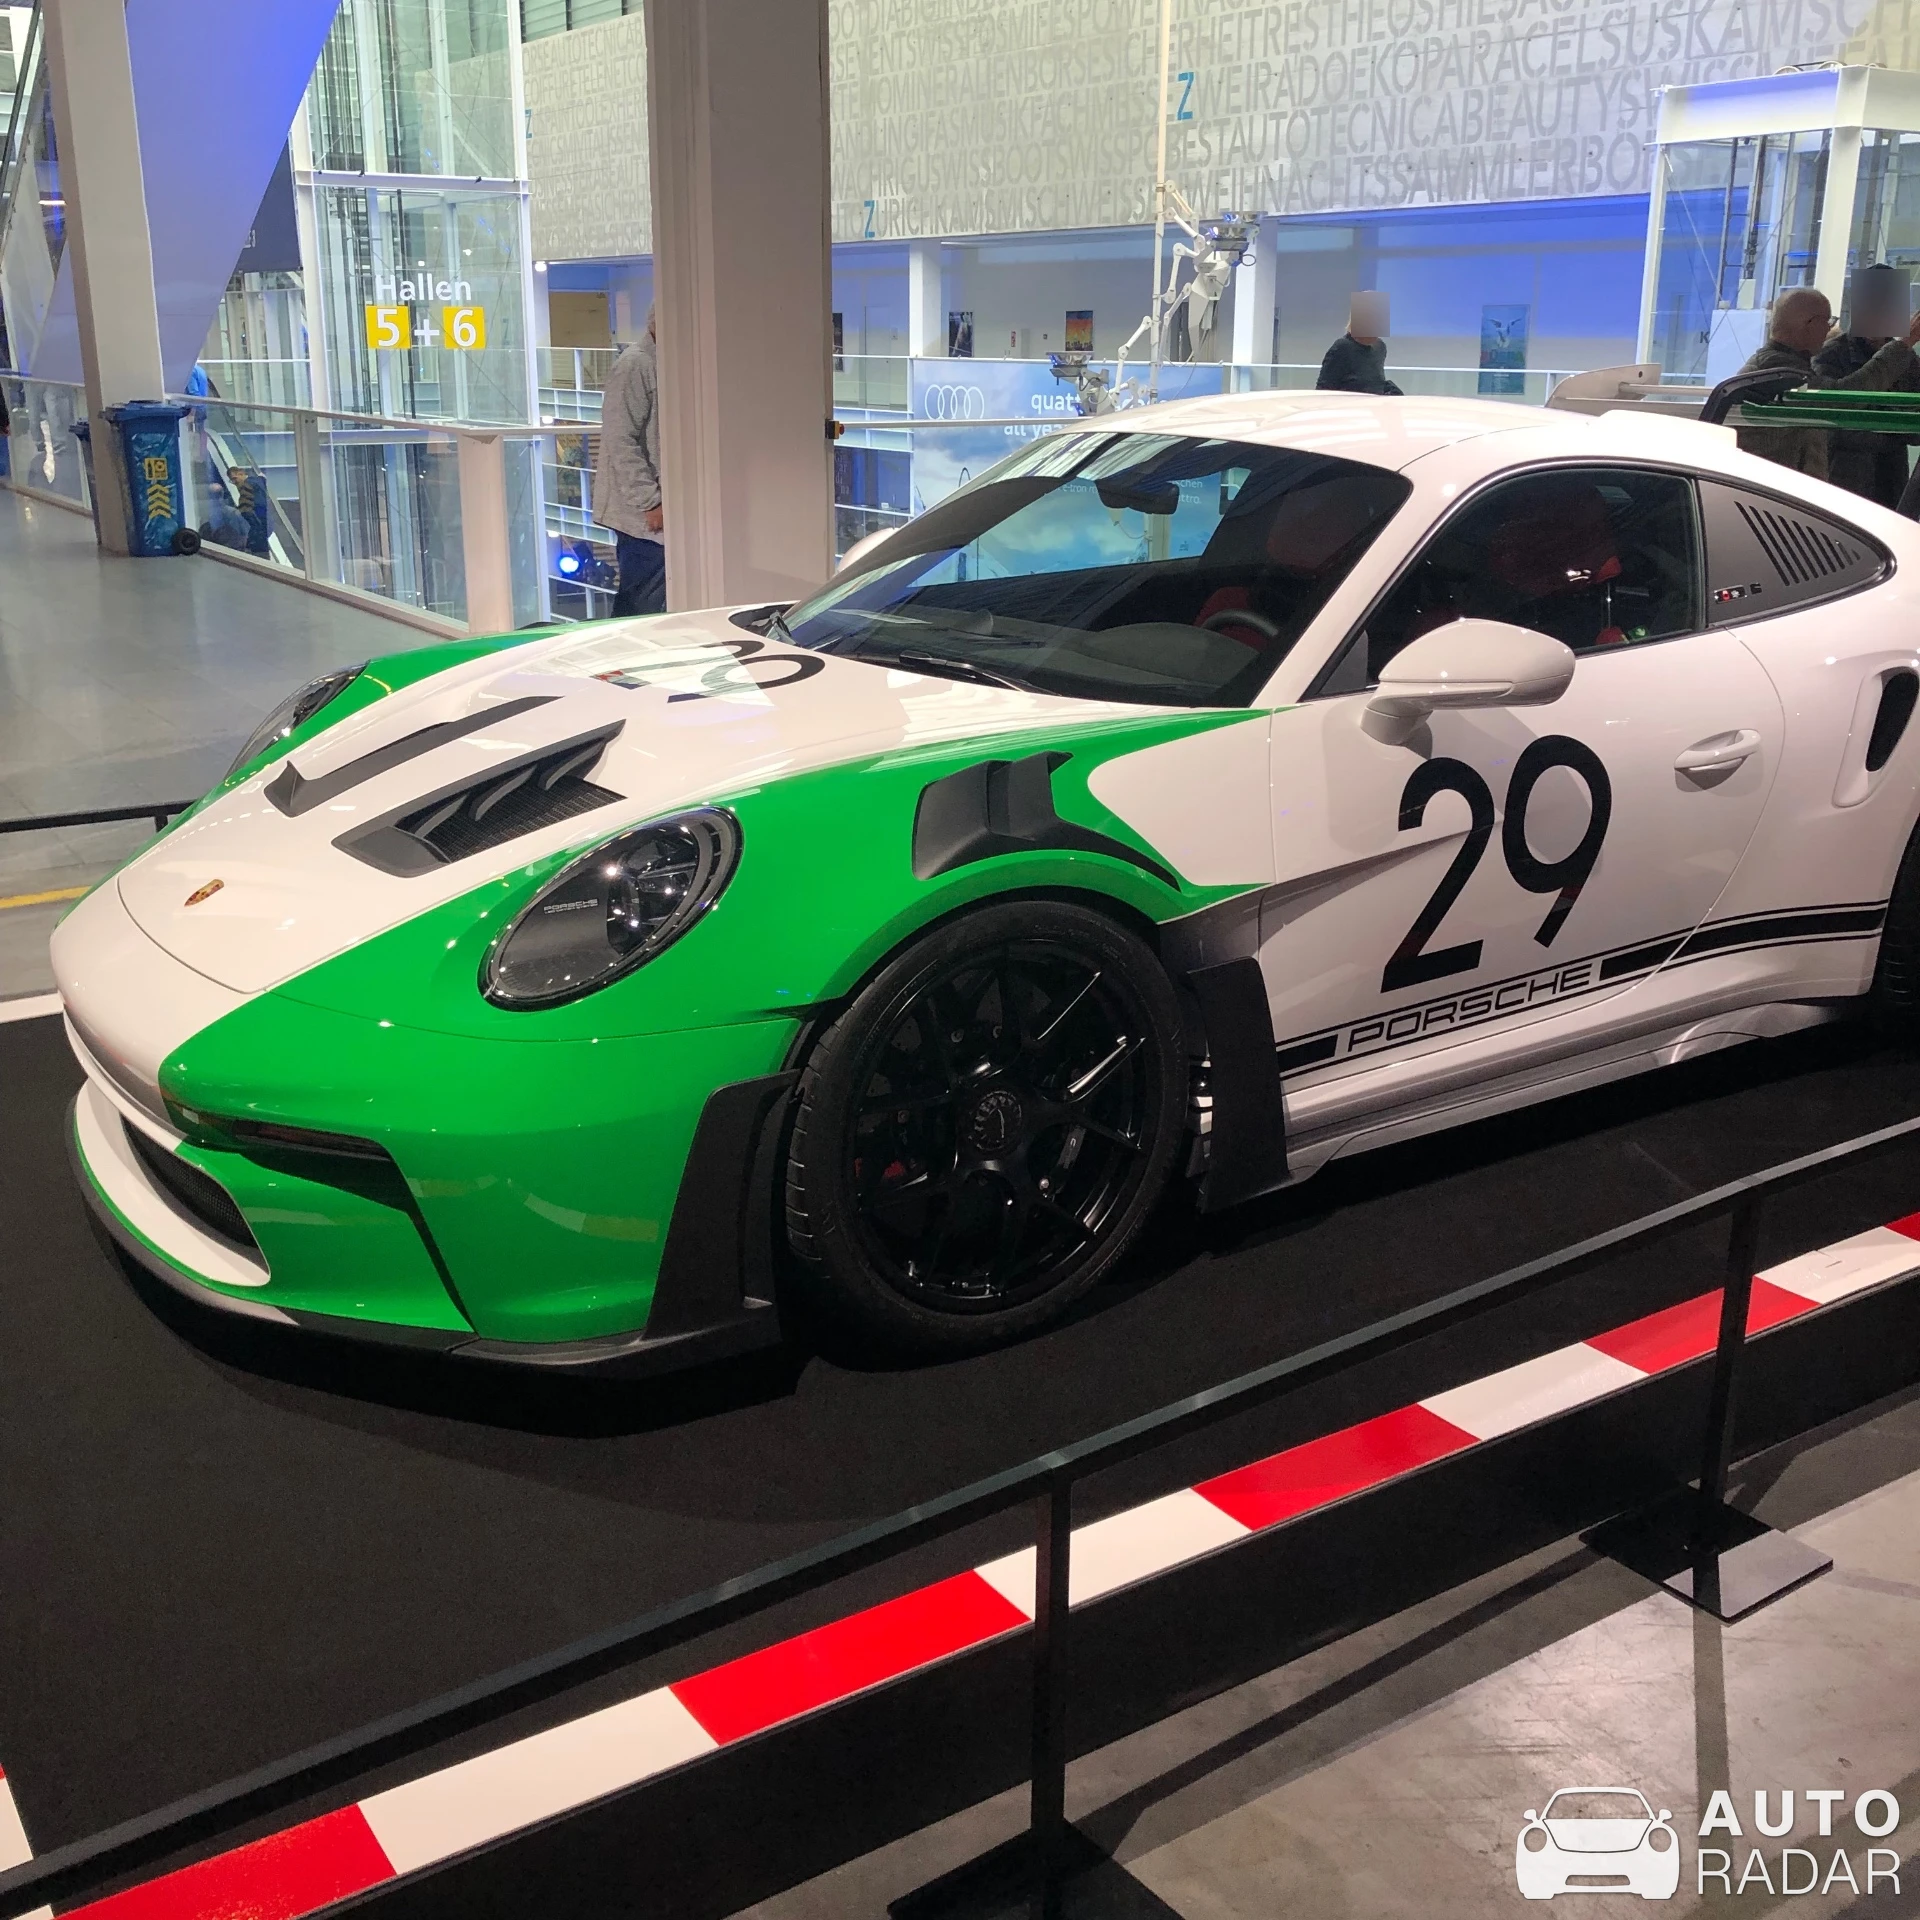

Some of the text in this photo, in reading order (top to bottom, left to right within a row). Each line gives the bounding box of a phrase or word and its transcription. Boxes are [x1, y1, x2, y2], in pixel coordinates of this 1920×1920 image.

[375, 273, 472, 301] Hallen
[377, 309, 477, 347] 5 + 6
[1380, 734, 1612, 994] 29
[1347, 963, 1593, 1053] PORSCHE
